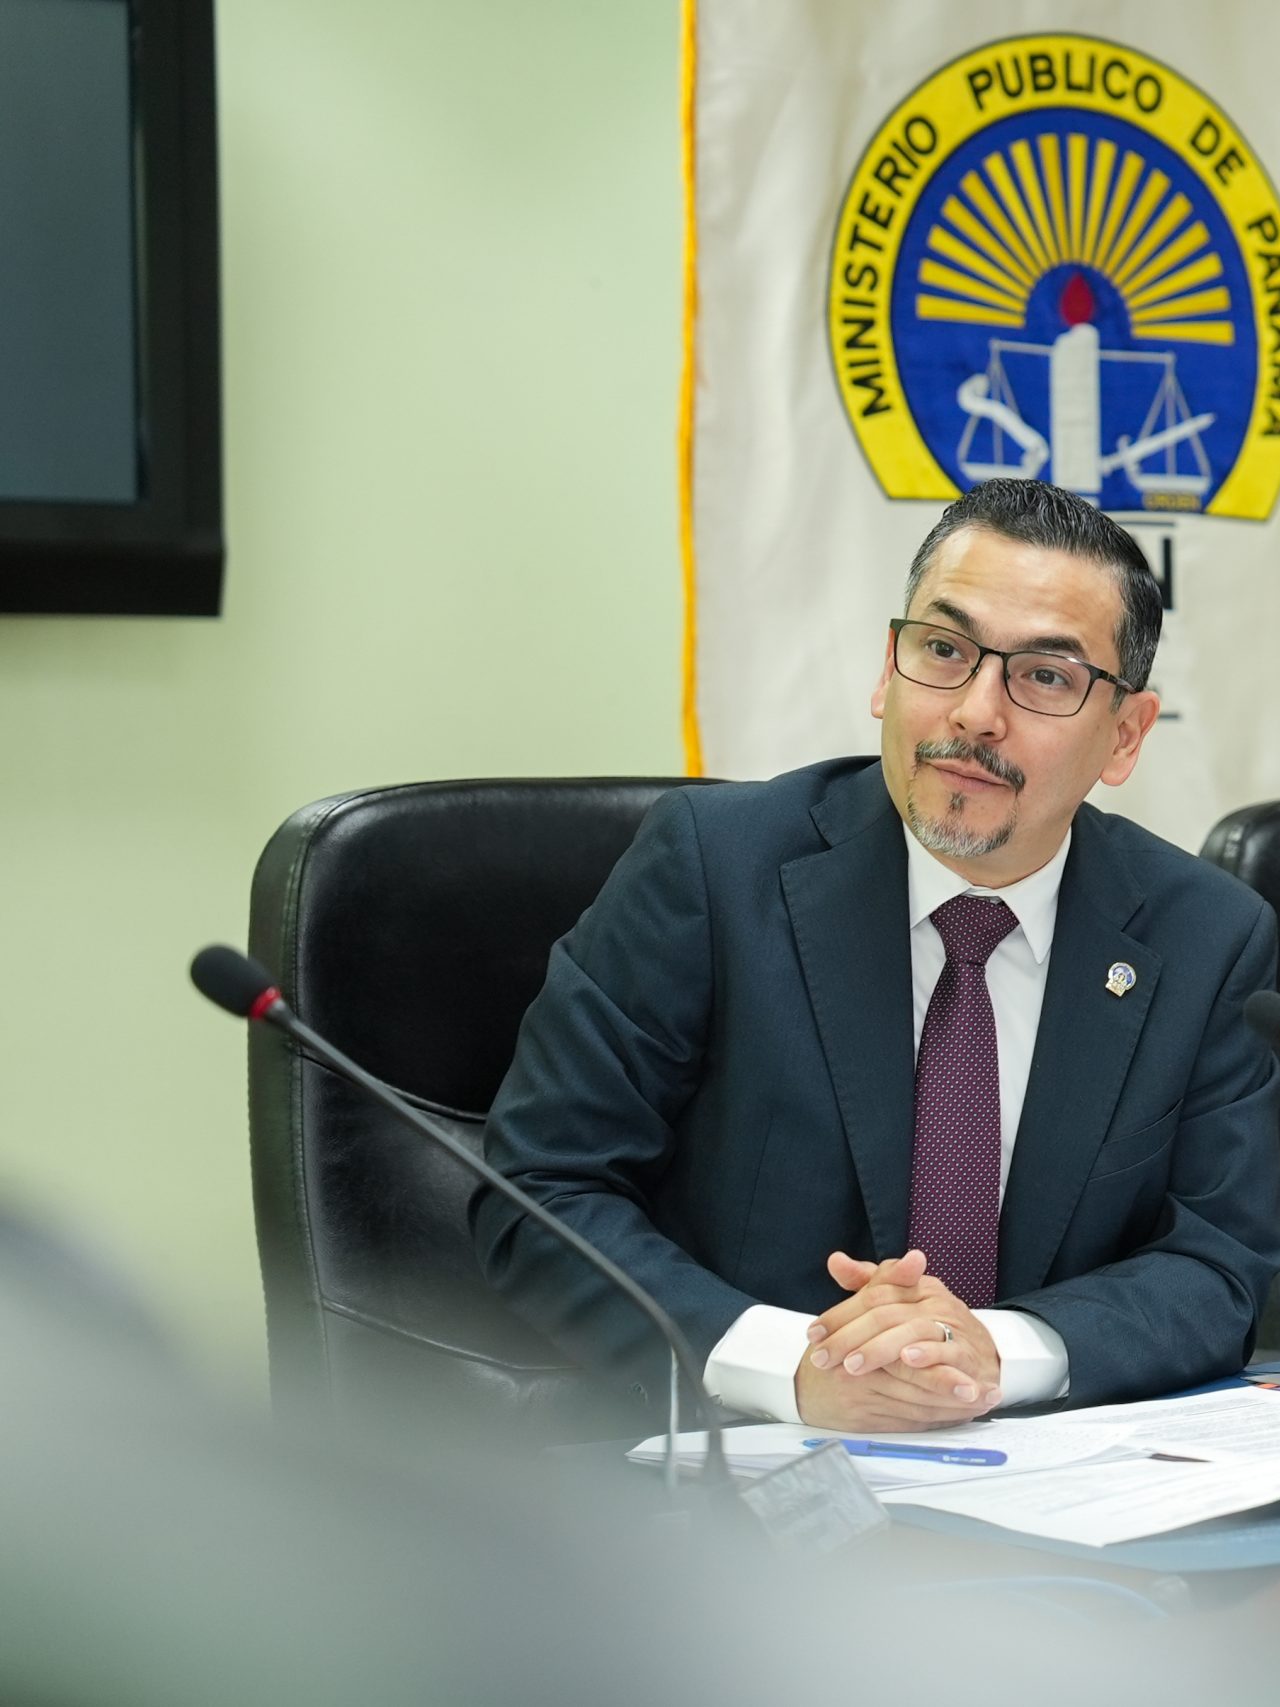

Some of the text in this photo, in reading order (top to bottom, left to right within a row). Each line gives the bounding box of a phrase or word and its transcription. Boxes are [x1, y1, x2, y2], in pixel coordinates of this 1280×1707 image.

[844, 115, 939, 417] MINISTERIO
[966, 51, 1164, 112] PUBLICO
[1189, 118, 1246, 187] DE
